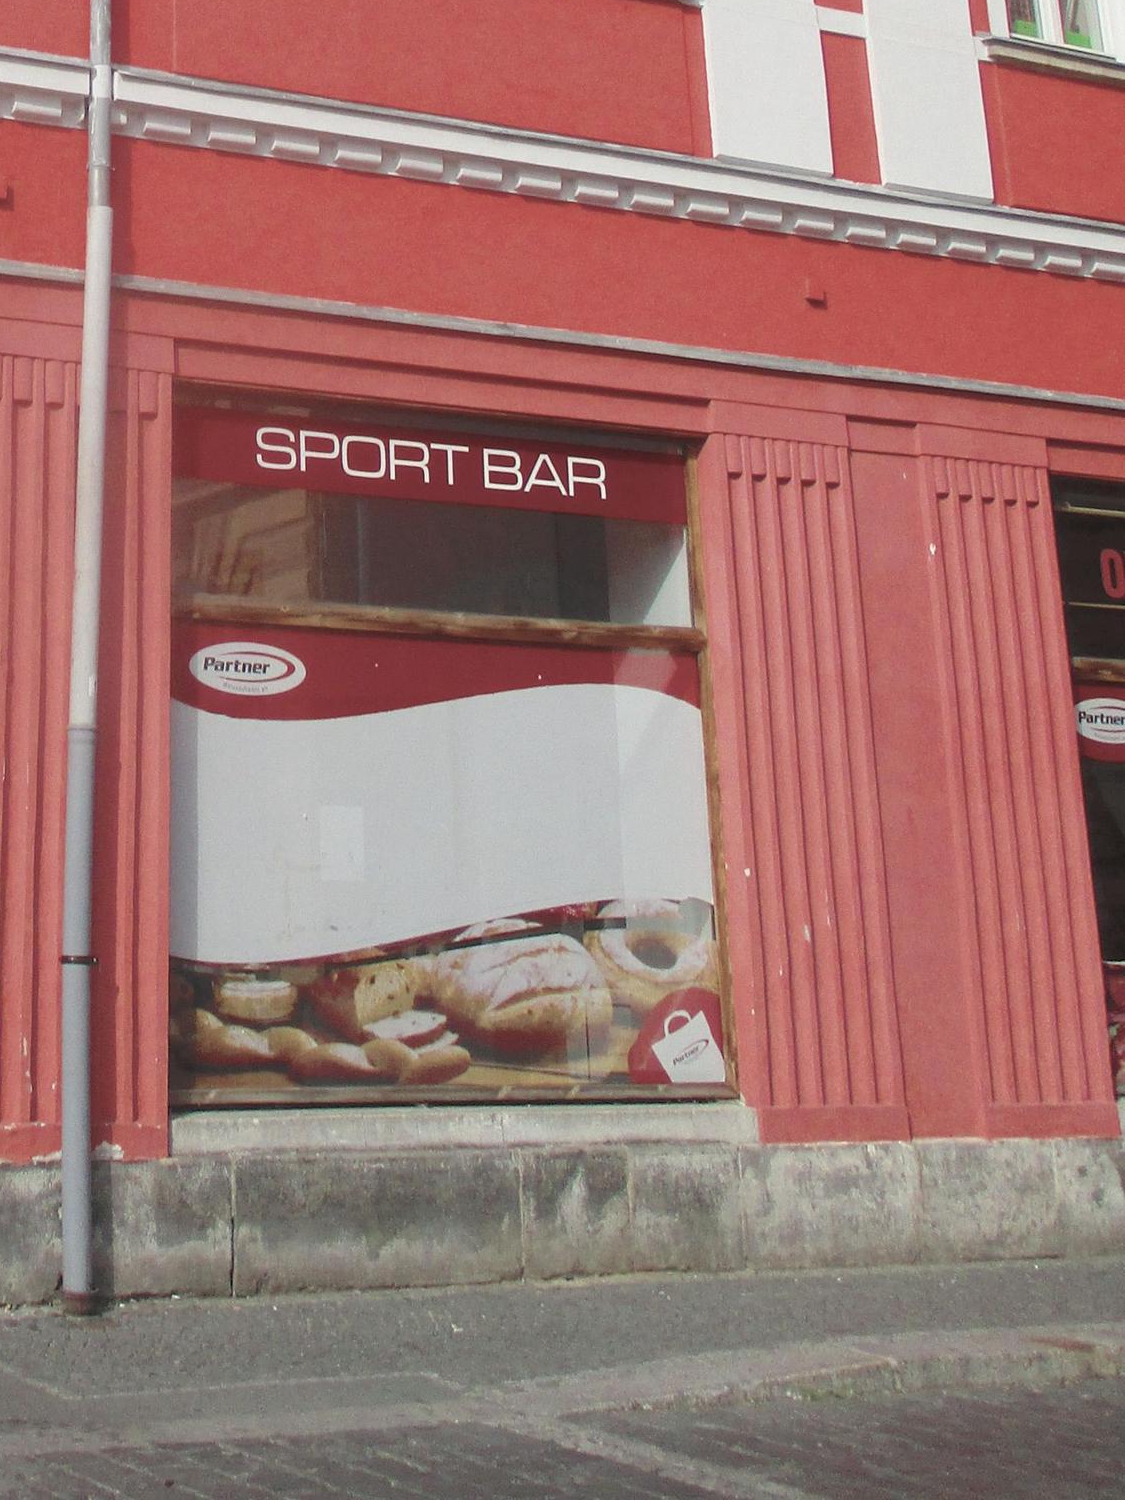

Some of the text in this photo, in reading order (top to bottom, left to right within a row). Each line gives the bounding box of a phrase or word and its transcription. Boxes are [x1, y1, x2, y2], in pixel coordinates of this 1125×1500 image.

[254, 426, 608, 501] SPORT BAR
[203, 656, 271, 675] Partner
